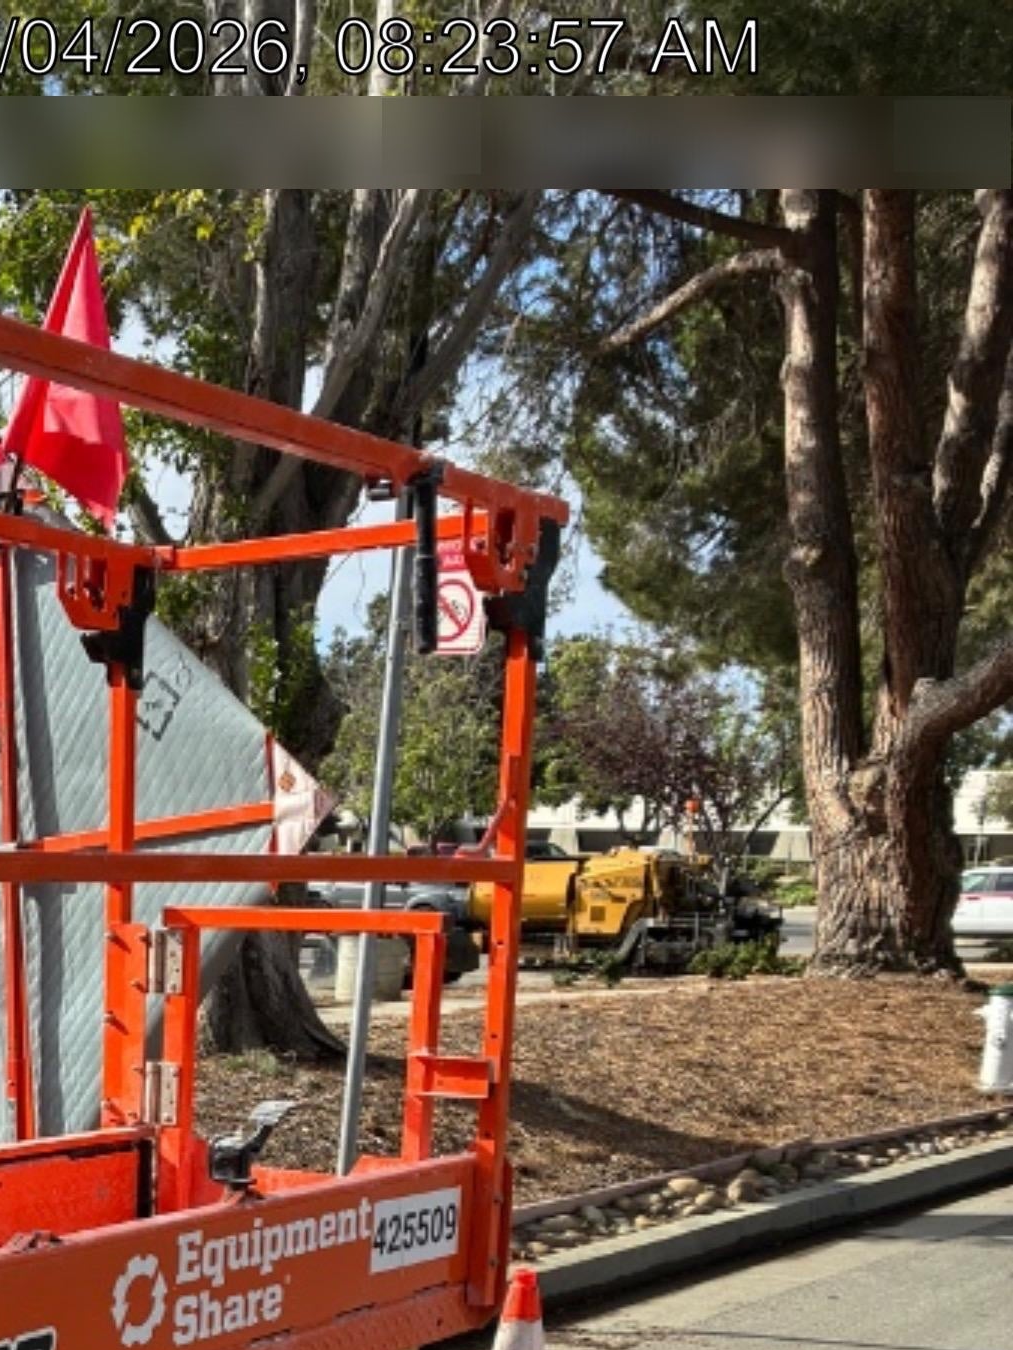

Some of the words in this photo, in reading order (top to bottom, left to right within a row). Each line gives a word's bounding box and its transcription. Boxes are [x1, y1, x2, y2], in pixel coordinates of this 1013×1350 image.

[175, 1197, 372, 1287] Equipment
[373, 1203, 457, 1256] 425509
[172, 1282, 283, 1346] Share
